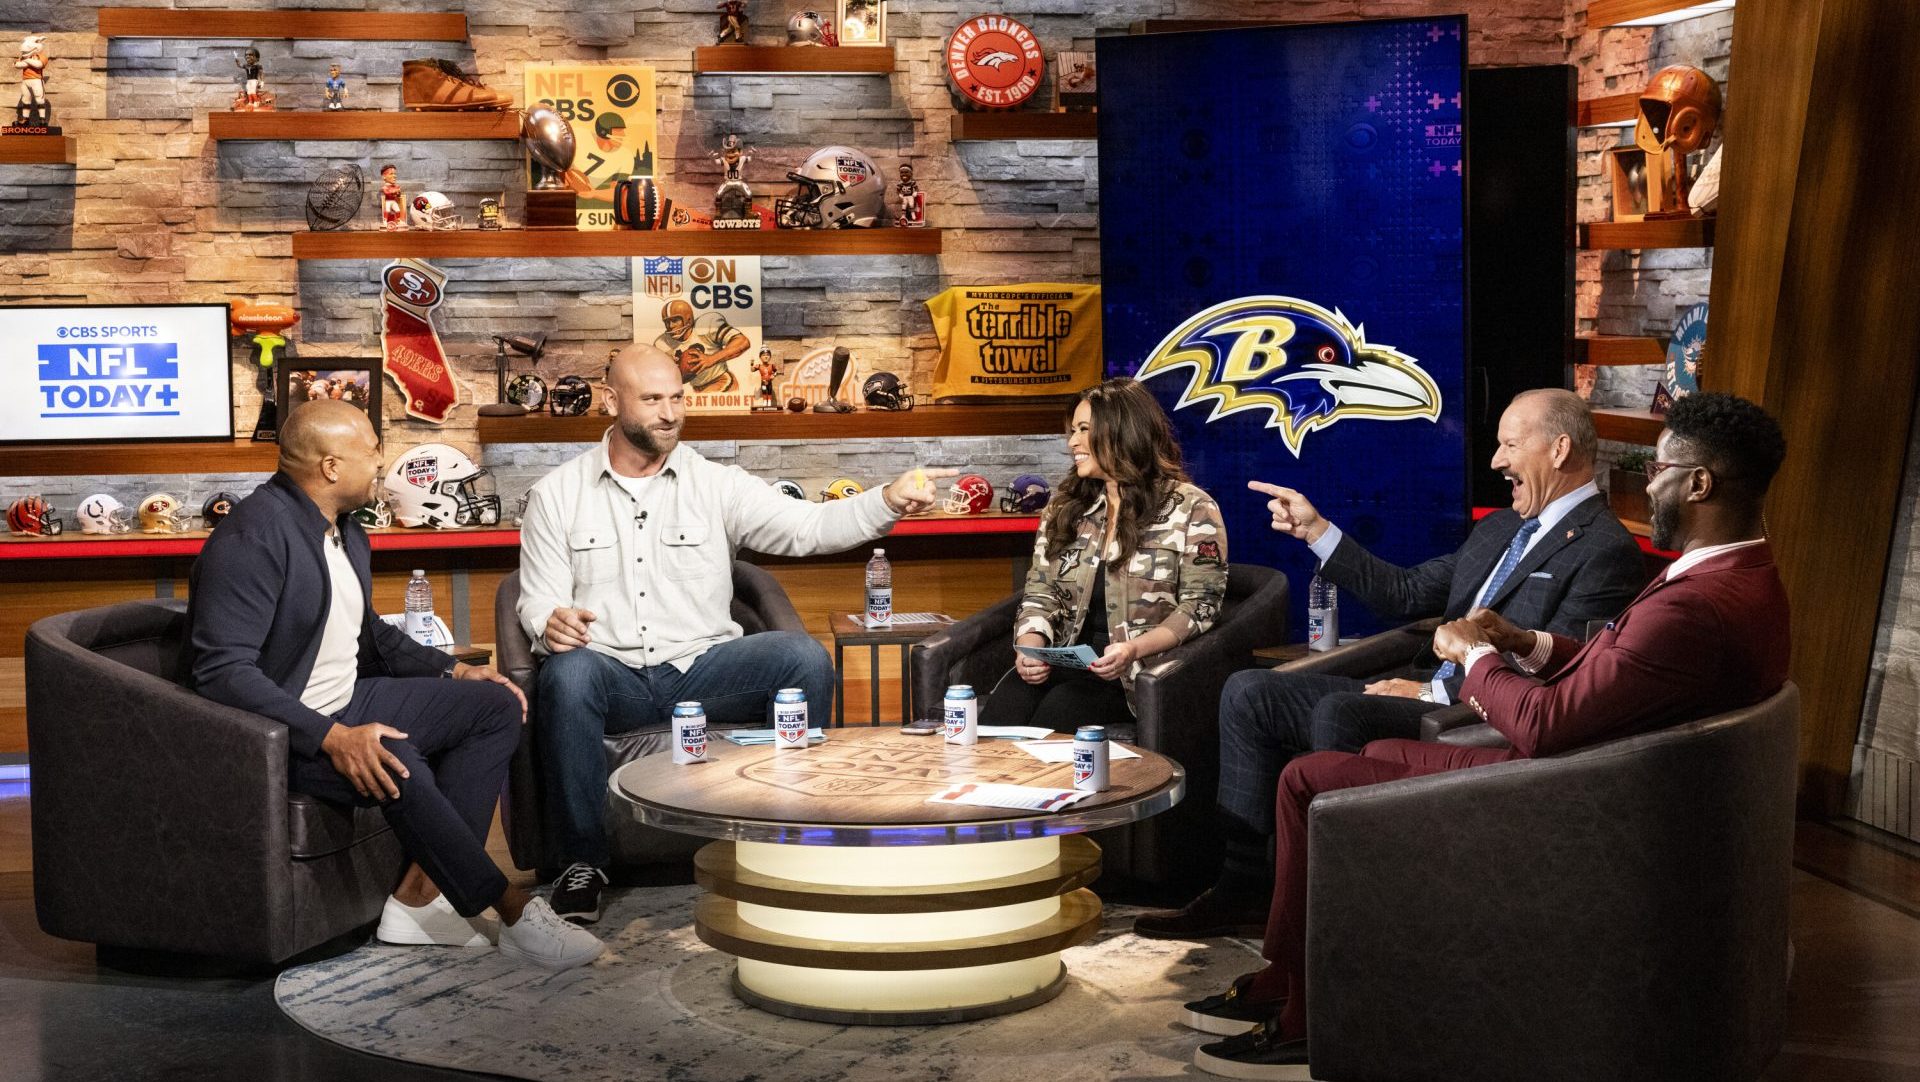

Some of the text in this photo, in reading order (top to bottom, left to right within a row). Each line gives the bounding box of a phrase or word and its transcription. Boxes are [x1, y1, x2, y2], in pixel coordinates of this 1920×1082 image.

[952, 17, 1039, 80] DENVER BRONCOS
[535, 73, 592, 97] NFL
[977, 75, 1035, 103] EST. 1960
[588, 212, 616, 226] SUN
[713, 219, 760, 229] COWBOYS
[647, 275, 682, 297] NFL
[690, 284, 754, 309] CBS
[1031, 292, 1068, 300] OFFICIAL
[981, 302, 1000, 310] The
[69, 325, 158, 339] CBS SPORTS
[966, 303, 1073, 340] terrible
[1675, 305, 1705, 342] MIAMI
[68, 347, 148, 377] NFL
[391, 344, 444, 383] 49ERS
[979, 337, 1057, 375] towel
[695, 394, 708, 406] AT
[711, 394, 740, 406] NOON
[743, 394, 755, 407] ET
[413, 460, 428, 468] NFL
[689, 728, 704, 737] NFL
